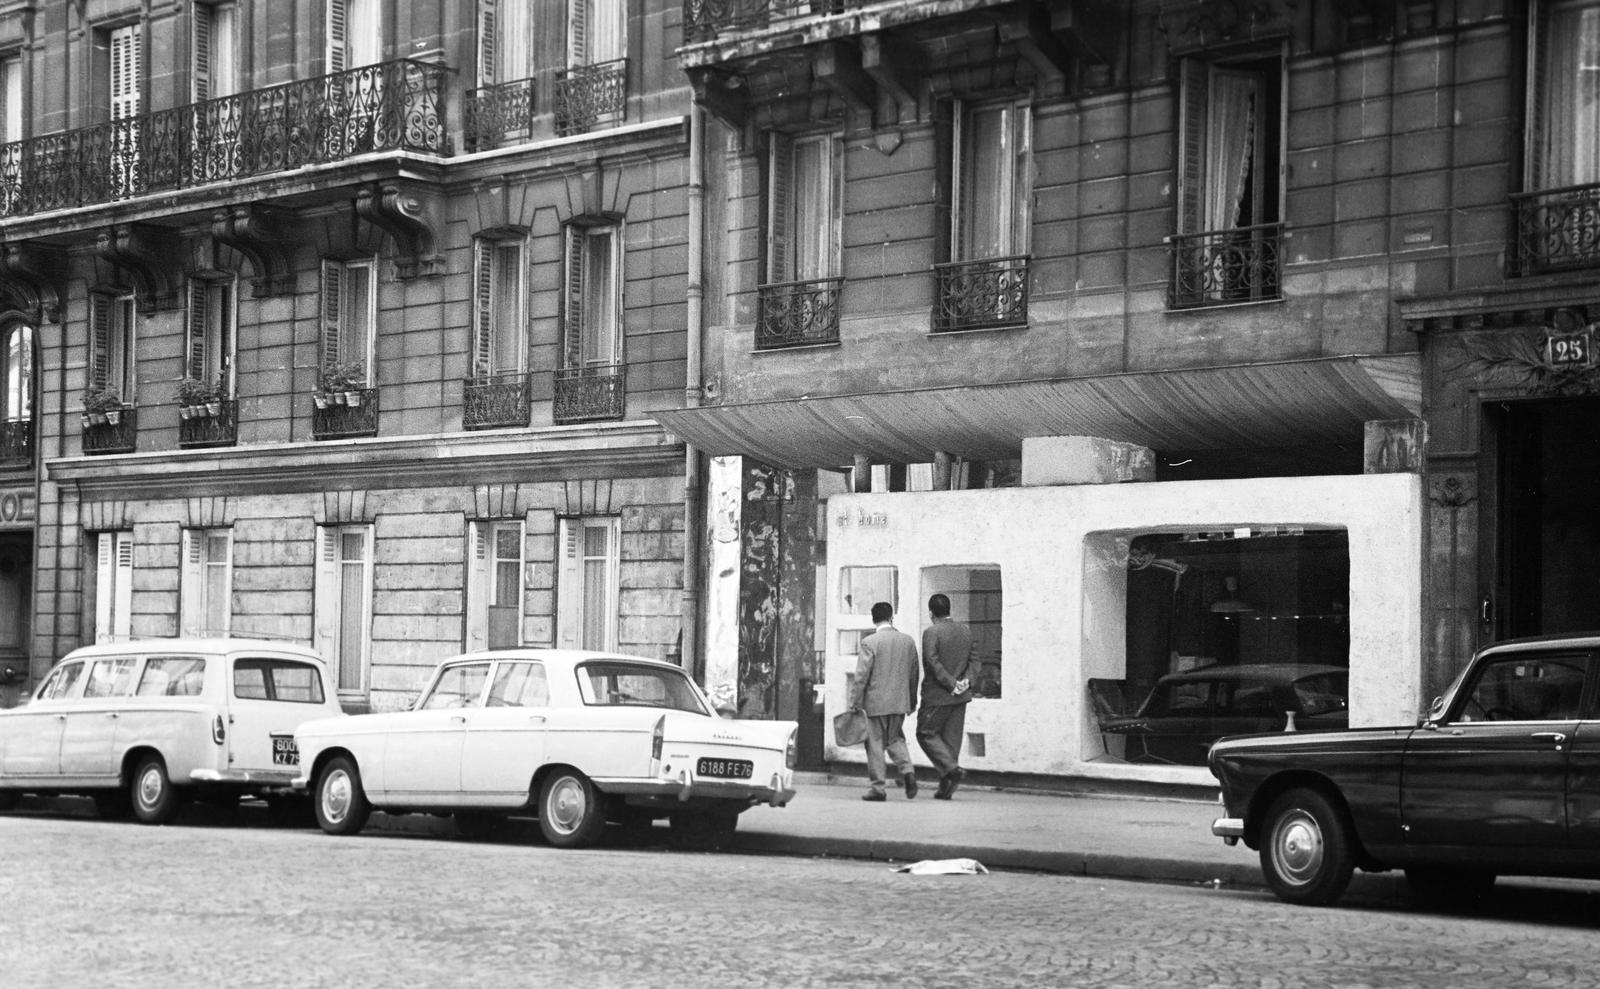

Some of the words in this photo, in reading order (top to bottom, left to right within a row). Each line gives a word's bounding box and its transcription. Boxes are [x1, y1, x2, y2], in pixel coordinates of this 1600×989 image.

[1556, 340, 1583, 361] 25
[700, 761, 725, 775] 6188
[727, 762, 740, 776] FE
[741, 763, 752, 777] 76
